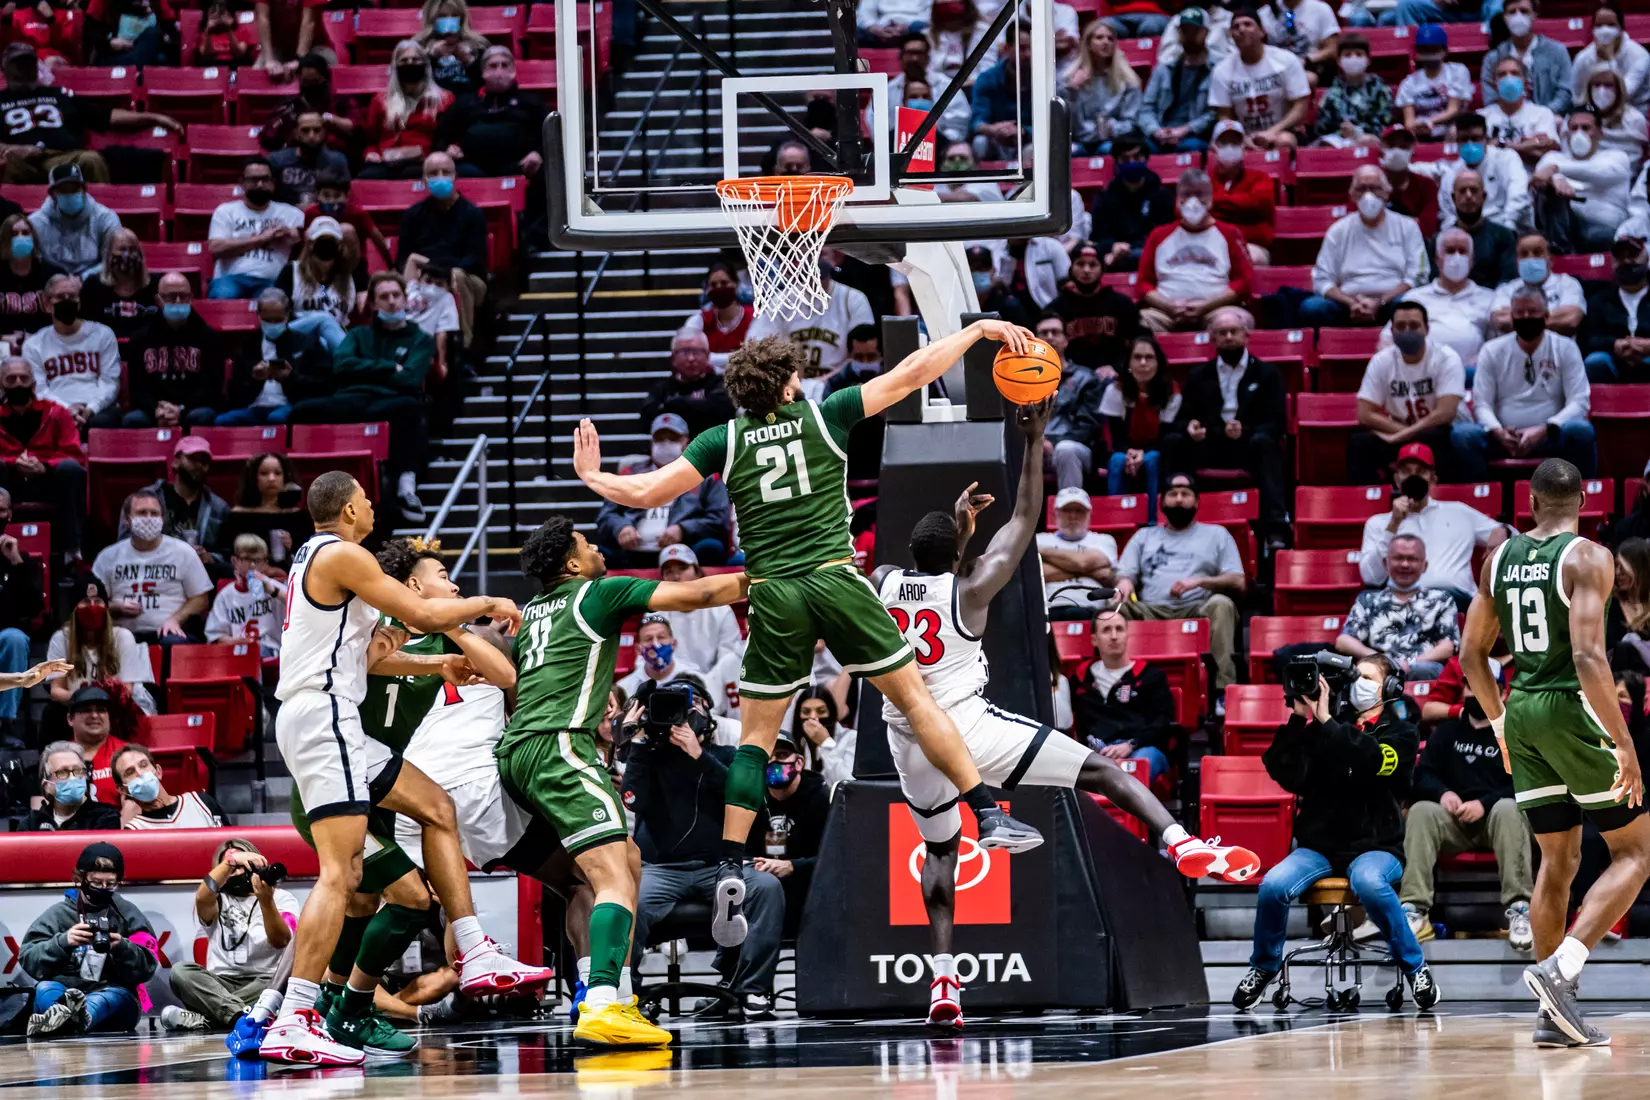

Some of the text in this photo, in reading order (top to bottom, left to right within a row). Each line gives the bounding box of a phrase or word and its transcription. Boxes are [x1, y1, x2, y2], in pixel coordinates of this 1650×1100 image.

[4, 104, 64, 135] 93
[44, 351, 101, 381] SDSU
[744, 417, 804, 447] RODDY
[755, 439, 813, 503] 21
[114, 565, 177, 580] SAN DIEGO
[1502, 563, 1550, 582] JACOBS
[525, 594, 567, 621] THOMAS
[899, 583, 927, 602] AROP
[1506, 587, 1551, 653] 13
[524, 616, 553, 671] 11
[384, 683, 400, 728] 1
